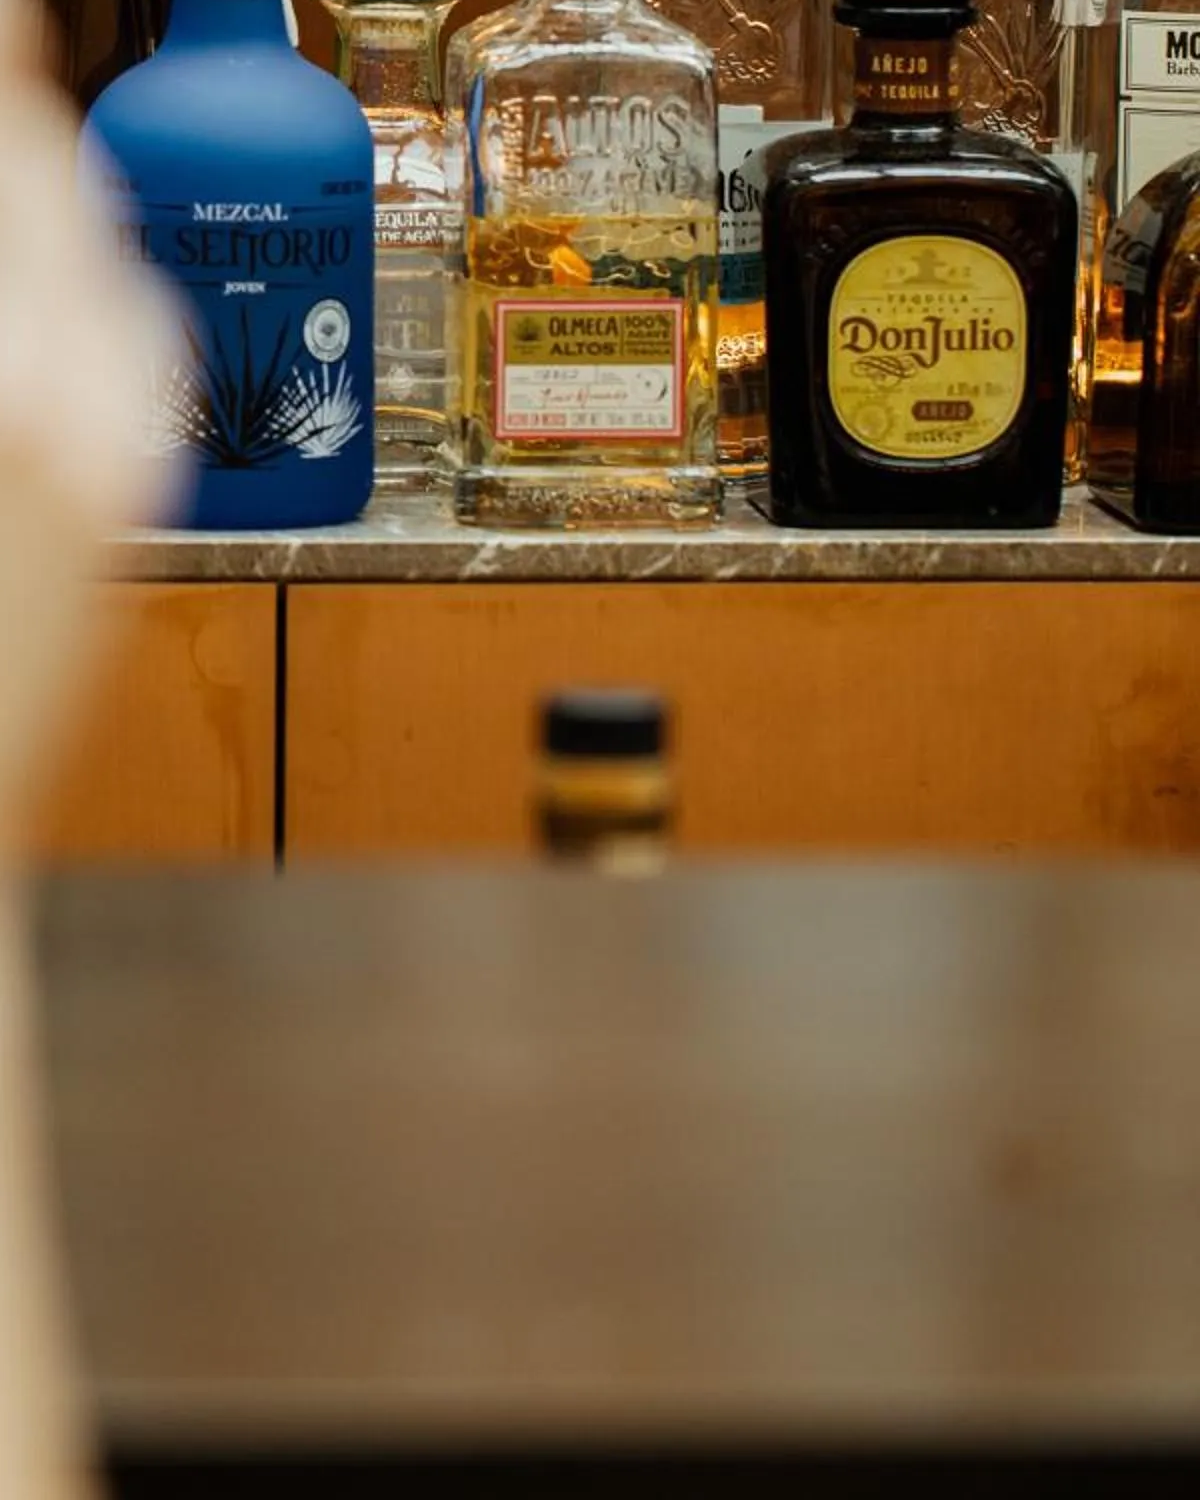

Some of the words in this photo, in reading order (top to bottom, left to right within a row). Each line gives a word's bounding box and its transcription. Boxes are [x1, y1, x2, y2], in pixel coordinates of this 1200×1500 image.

[871, 54, 929, 76] AÑEJO
[881, 85, 940, 99] TEQUILA
[193, 202, 289, 222] MEZCAL
[374, 211, 439, 229] EQUILA
[223, 280, 267, 296] JOVEN
[548, 315, 619, 338] OLMECA
[550, 341, 618, 357] ALTOS
